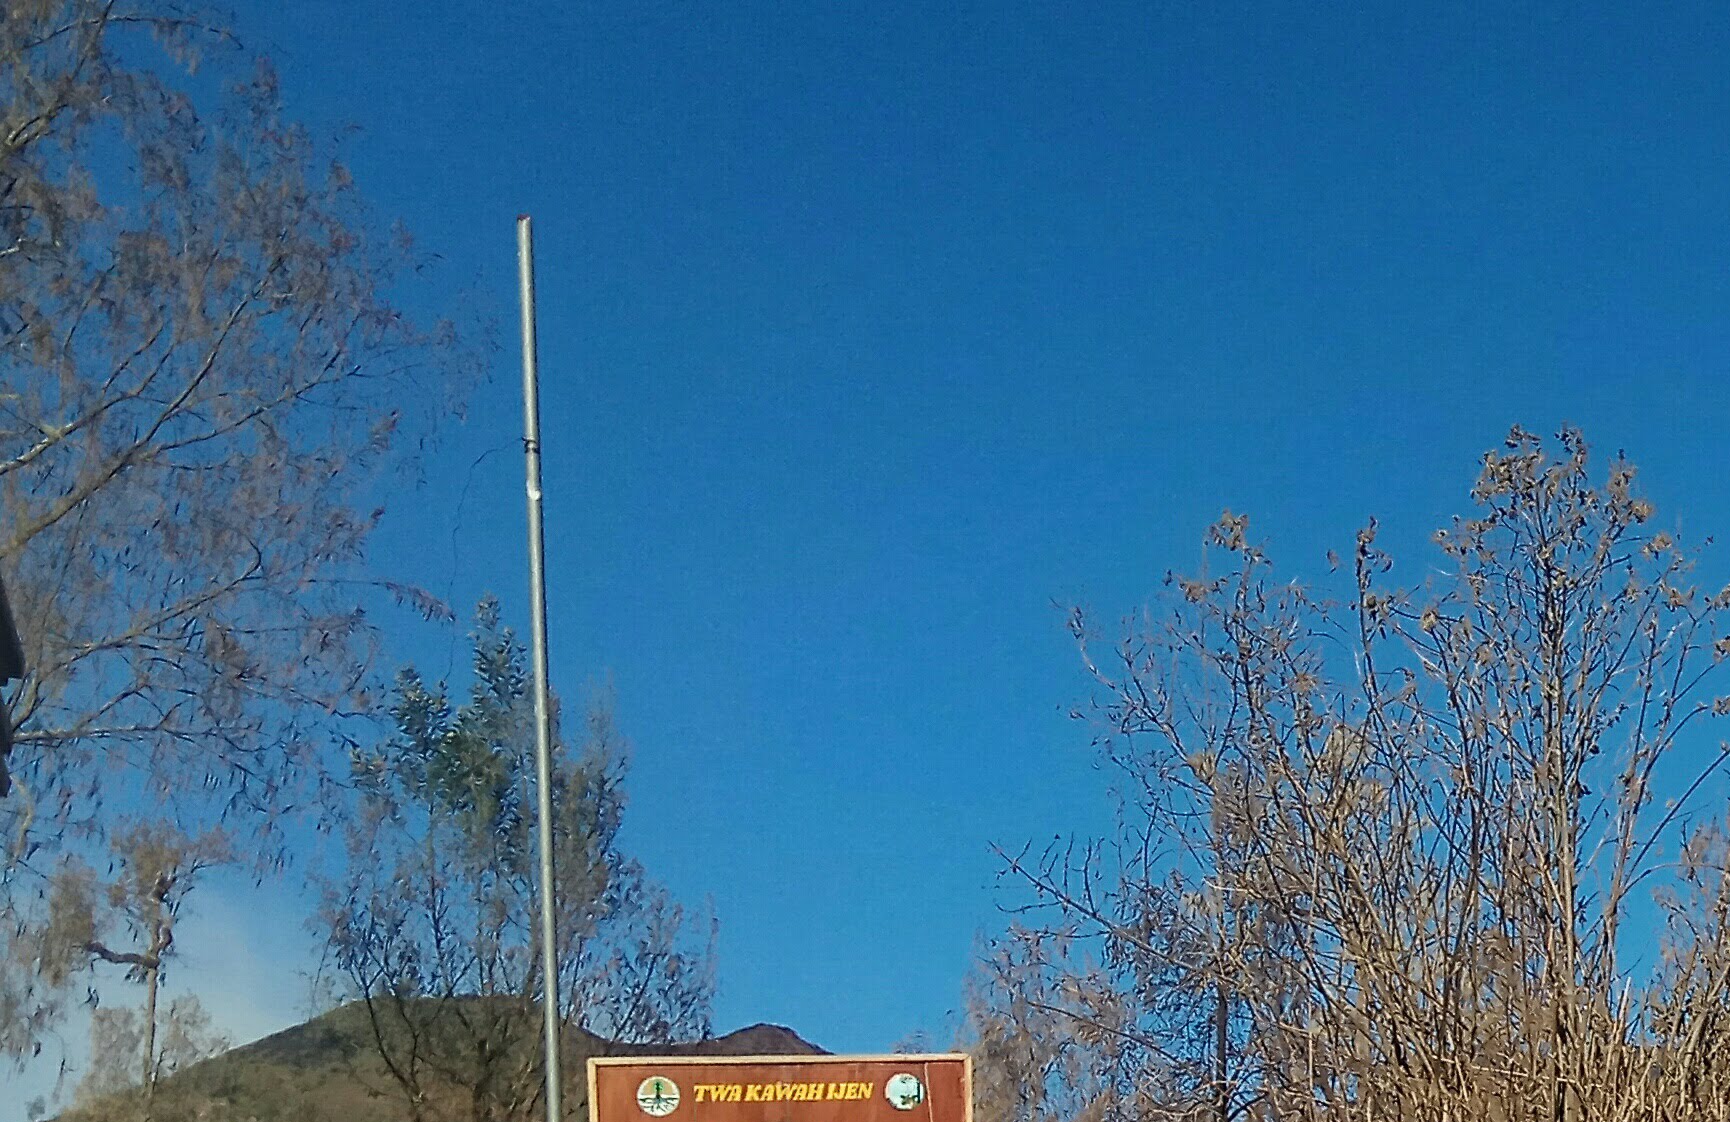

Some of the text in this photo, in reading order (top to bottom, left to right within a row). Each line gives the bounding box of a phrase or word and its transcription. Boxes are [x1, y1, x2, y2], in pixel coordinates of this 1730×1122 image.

[694, 1082, 874, 1102] TWA KAWAH IJEN
